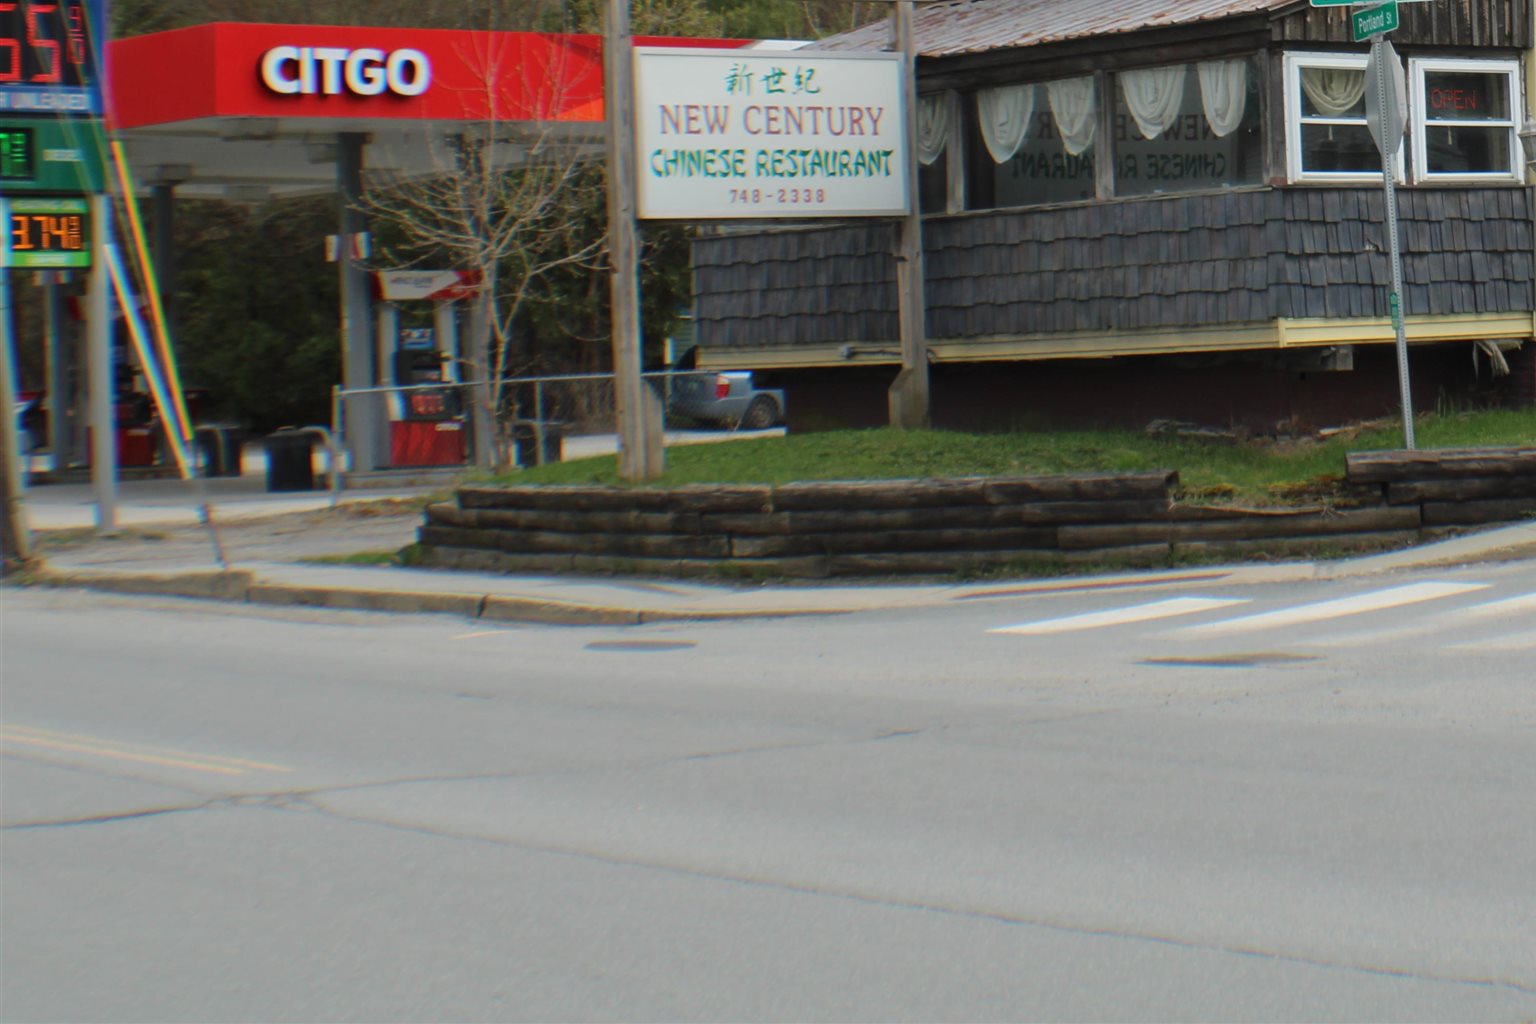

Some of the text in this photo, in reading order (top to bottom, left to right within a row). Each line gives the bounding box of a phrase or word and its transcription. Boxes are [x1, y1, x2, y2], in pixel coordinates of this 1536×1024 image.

[1359, 11, 1393, 34] Portland St
[261, 45, 433, 96] CITGO
[724, 63, 821, 96] 新世紀
[1430, 86, 1478, 111] OPEN
[658, 104, 884, 136] NEW CENTURY
[650, 148, 895, 178] CHINESE RESTAURANT
[729, 189, 826, 204] 748-2338
